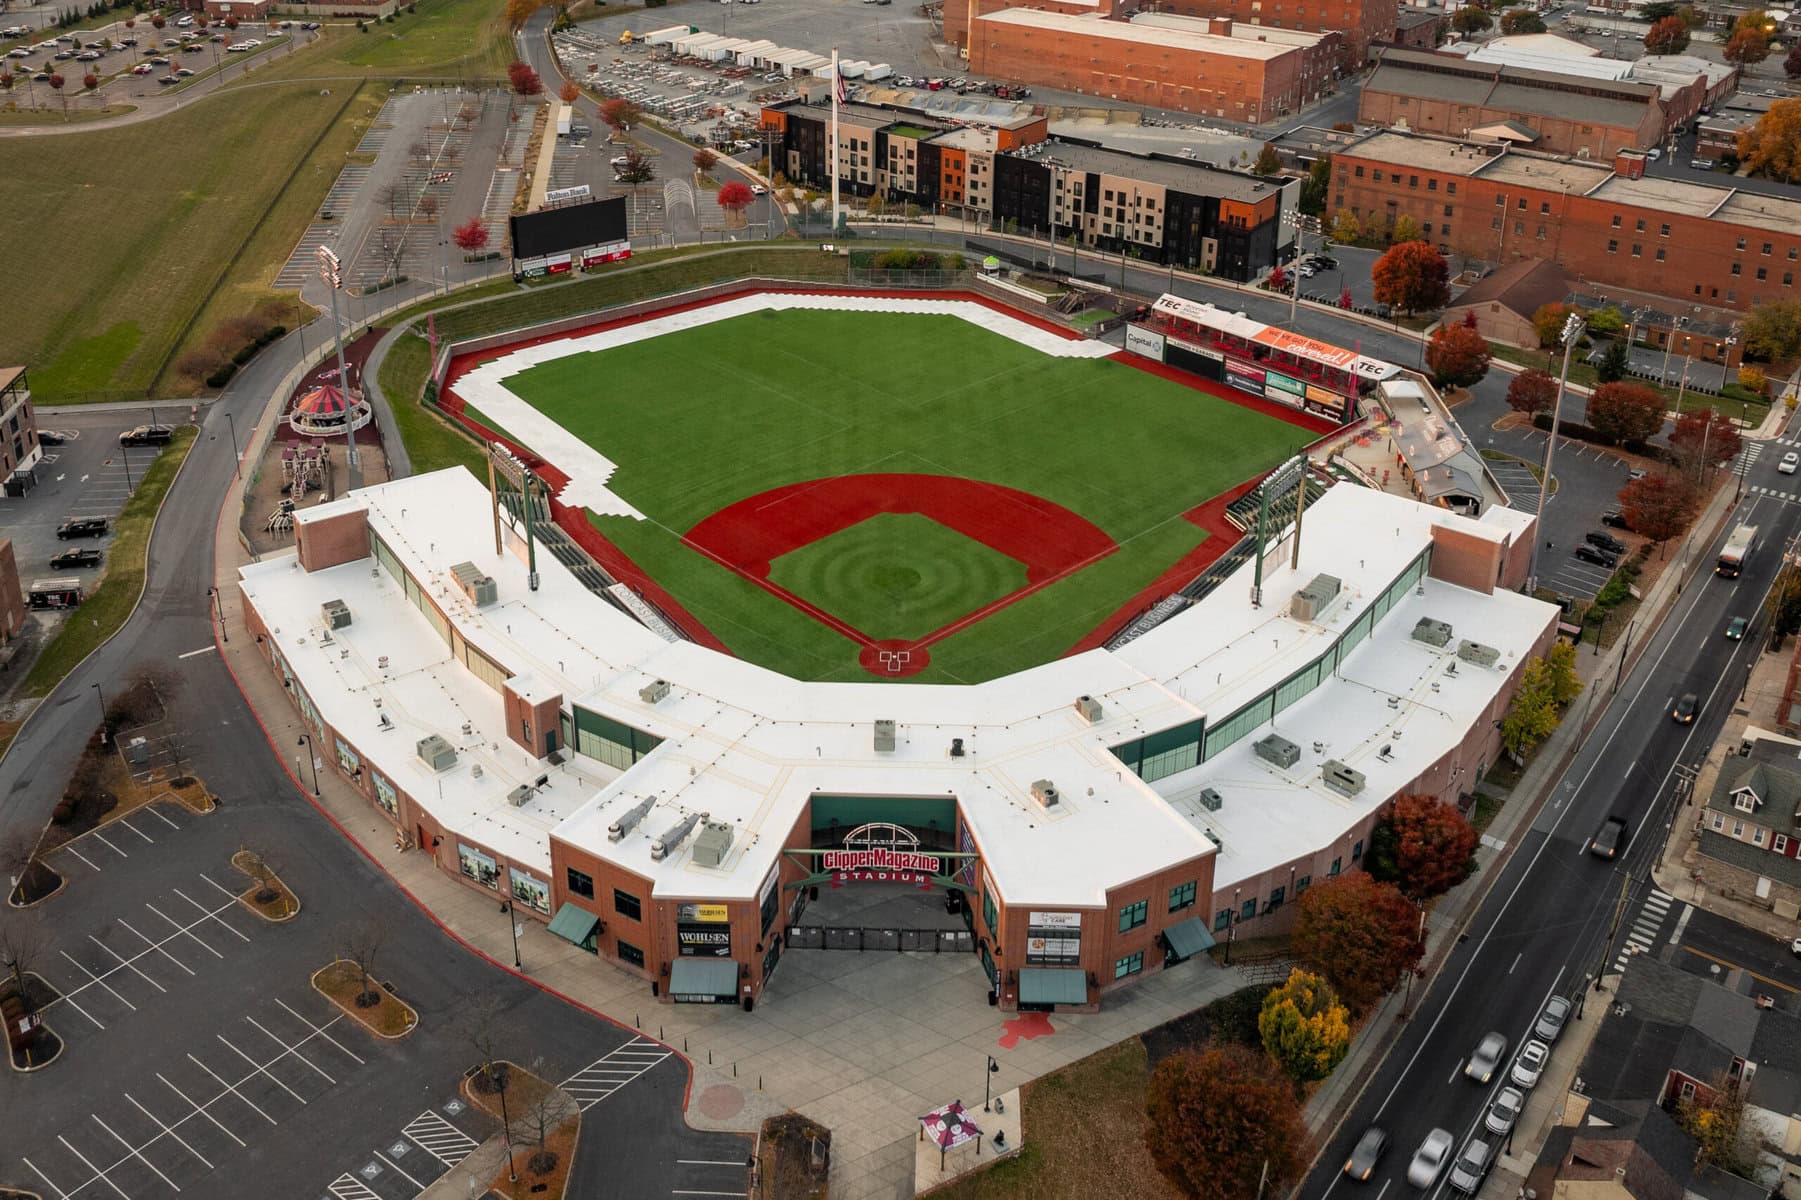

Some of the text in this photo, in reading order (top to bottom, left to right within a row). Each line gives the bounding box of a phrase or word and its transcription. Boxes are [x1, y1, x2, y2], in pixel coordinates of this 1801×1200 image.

[570, 186, 588, 196] Bank
[1159, 298, 1181, 310] TEC
[1127, 333, 1153, 348] Capital
[1307, 340, 1325, 352] YOU
[1359, 361, 1385, 375] TEC
[839, 872, 925, 883] STADIUM
[679, 932, 729, 942] WOHLSEN
